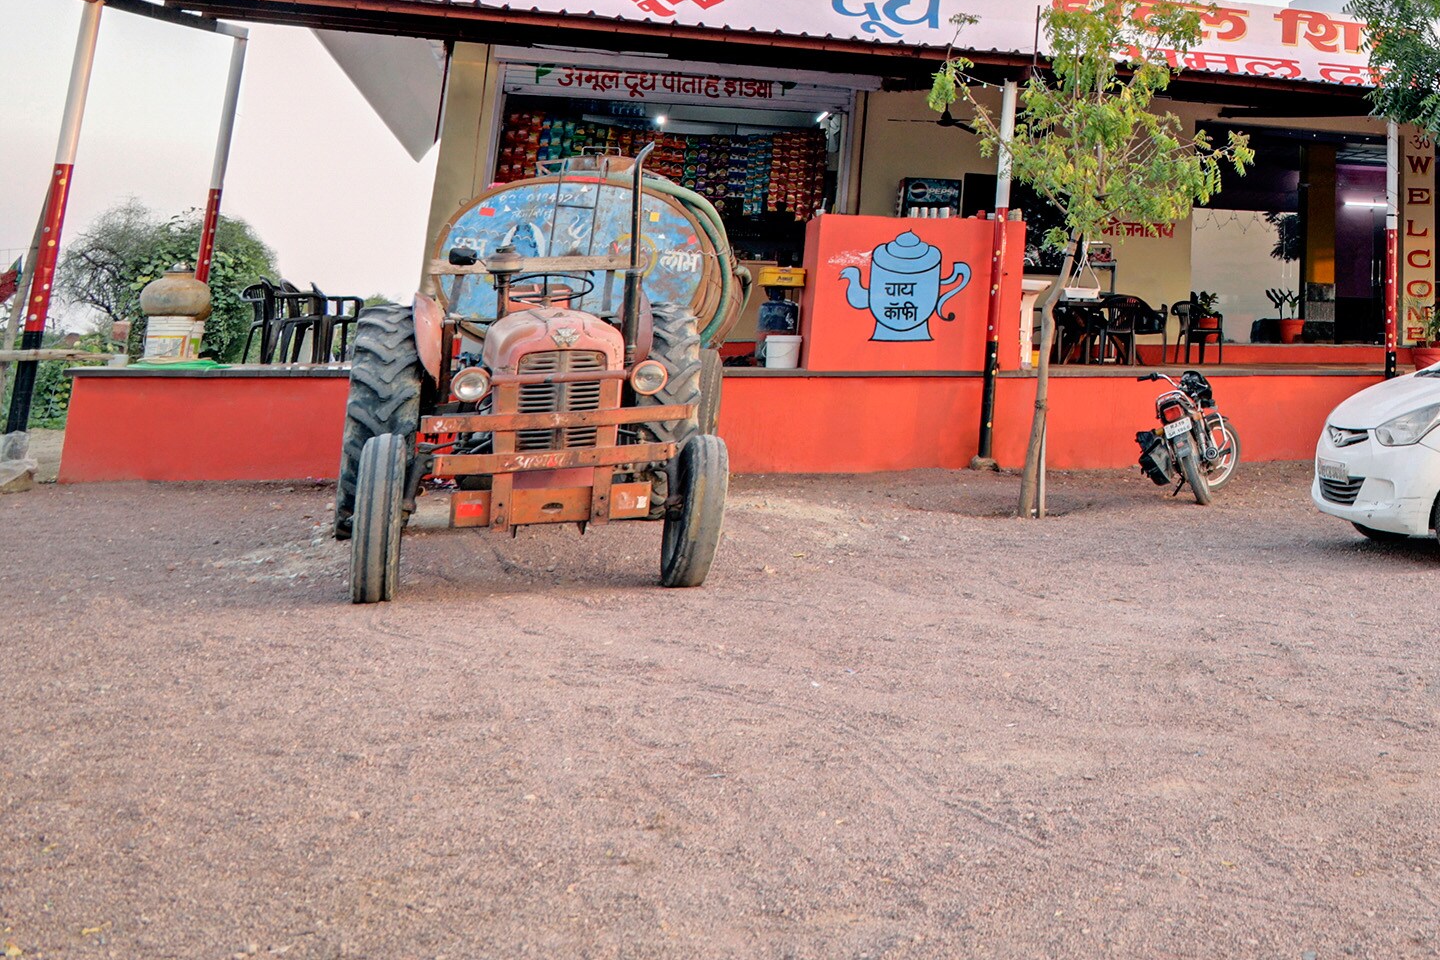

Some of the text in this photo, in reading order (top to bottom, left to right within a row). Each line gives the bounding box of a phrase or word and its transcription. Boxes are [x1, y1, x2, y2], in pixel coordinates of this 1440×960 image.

[557, 67, 622, 92] अमूल
[623, 71, 659, 97] दूध
[1406, 155, 1433, 341] WELCOME
[885, 282, 917, 297] चाय
[884, 302, 919, 322] कॉफी
